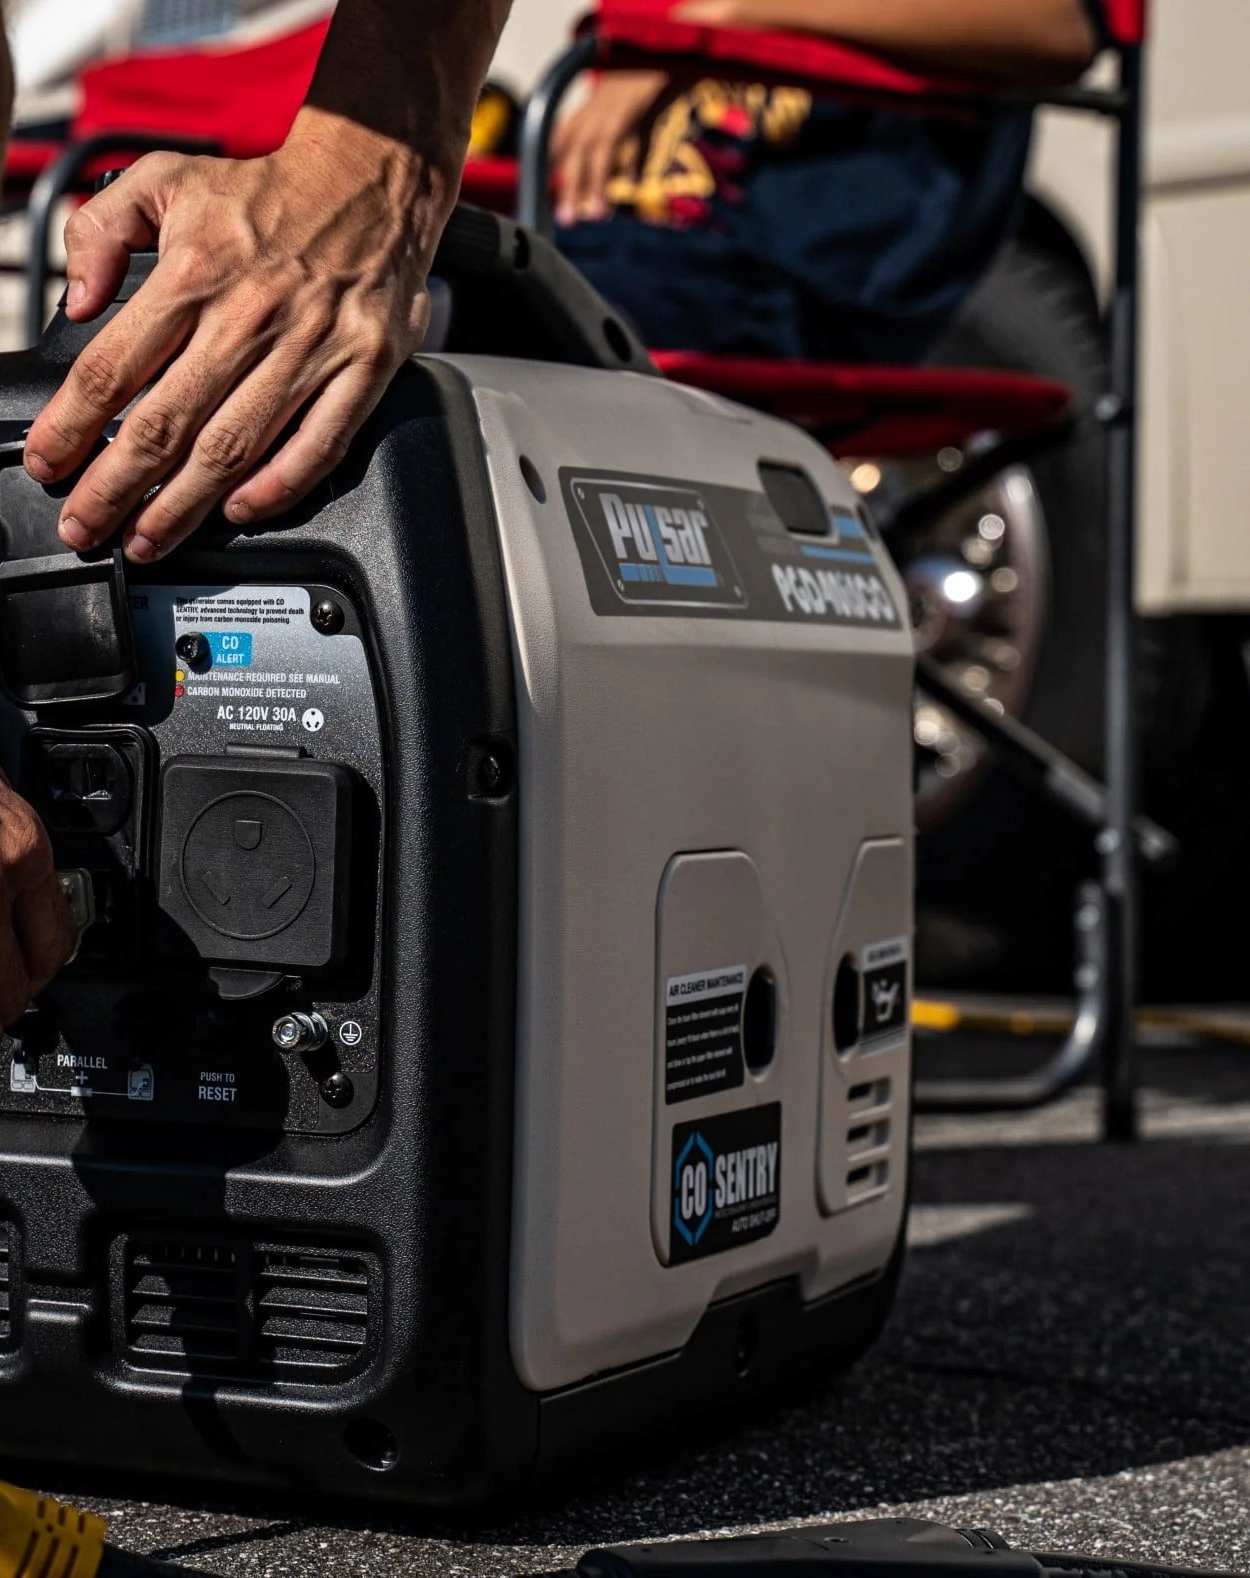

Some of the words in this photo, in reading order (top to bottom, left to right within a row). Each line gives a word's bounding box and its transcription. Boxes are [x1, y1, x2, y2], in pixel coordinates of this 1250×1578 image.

[236, 598, 261, 606] equipped
[228, 607, 257, 615] technology
[183, 615, 199, 623] injury
[222, 636, 239, 650] CO
[216, 654, 244, 664] ALERT
[187, 672, 243, 682] MAINTENANCE
[245, 672, 286, 683] REQUIRED
[289, 673, 303, 683] SEE
[306, 674, 340, 684] MANUAL
[187, 687, 219, 697] CARBON
[222, 687, 264, 698] MONOXIDE
[266, 688, 306, 699] DETECTED
[217, 705, 234, 720] AC
[238, 706, 269, 721] 120V
[272, 707, 297, 722] 30A
[256, 723, 283, 731] FLOATING
[669, 983, 680, 997] AIR
[680, 979, 706, 996] CLEANER
[57, 1054, 108, 1069] PARALLEL
[200, 1072, 223, 1083] PUSH
[224, 1073, 235, 1083] TO
[198, 1085, 237, 1102] RESET
[681, 1161, 707, 1220] CO
[715, 1141, 778, 1209] SENTRY
